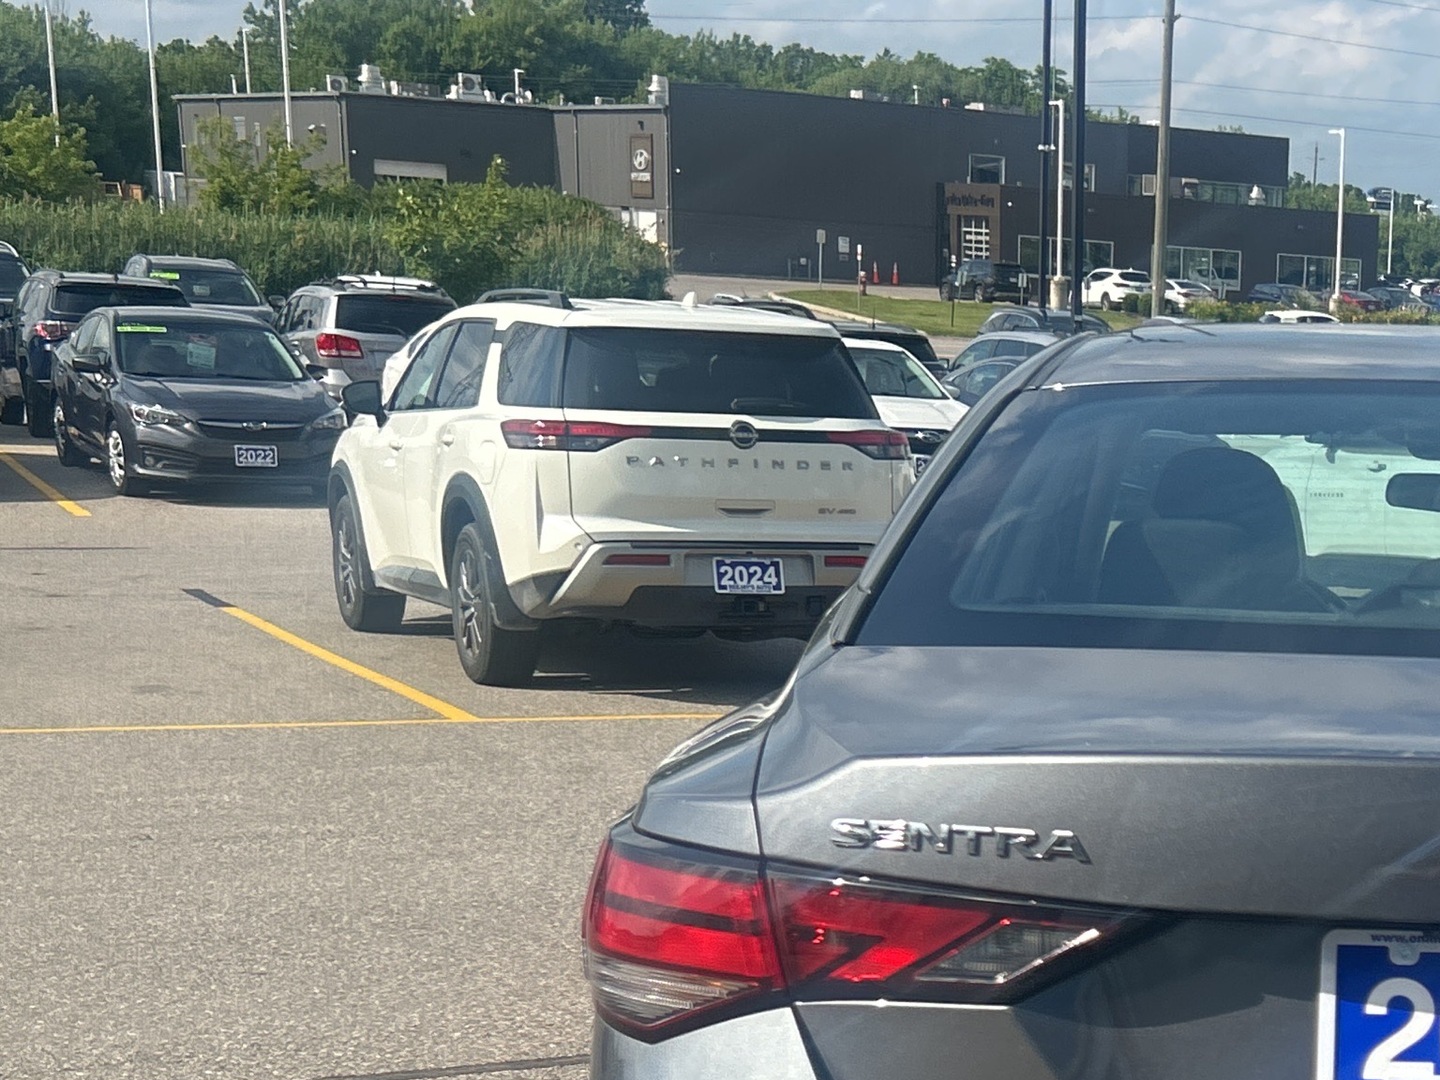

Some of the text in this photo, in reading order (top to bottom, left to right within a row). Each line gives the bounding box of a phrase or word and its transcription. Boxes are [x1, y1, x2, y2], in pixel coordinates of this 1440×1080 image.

[238, 450, 274, 463] 2022
[626, 456, 854, 471] PATHFINDER
[719, 565, 778, 586] 2024
[830, 817, 1093, 866] SENTRA
